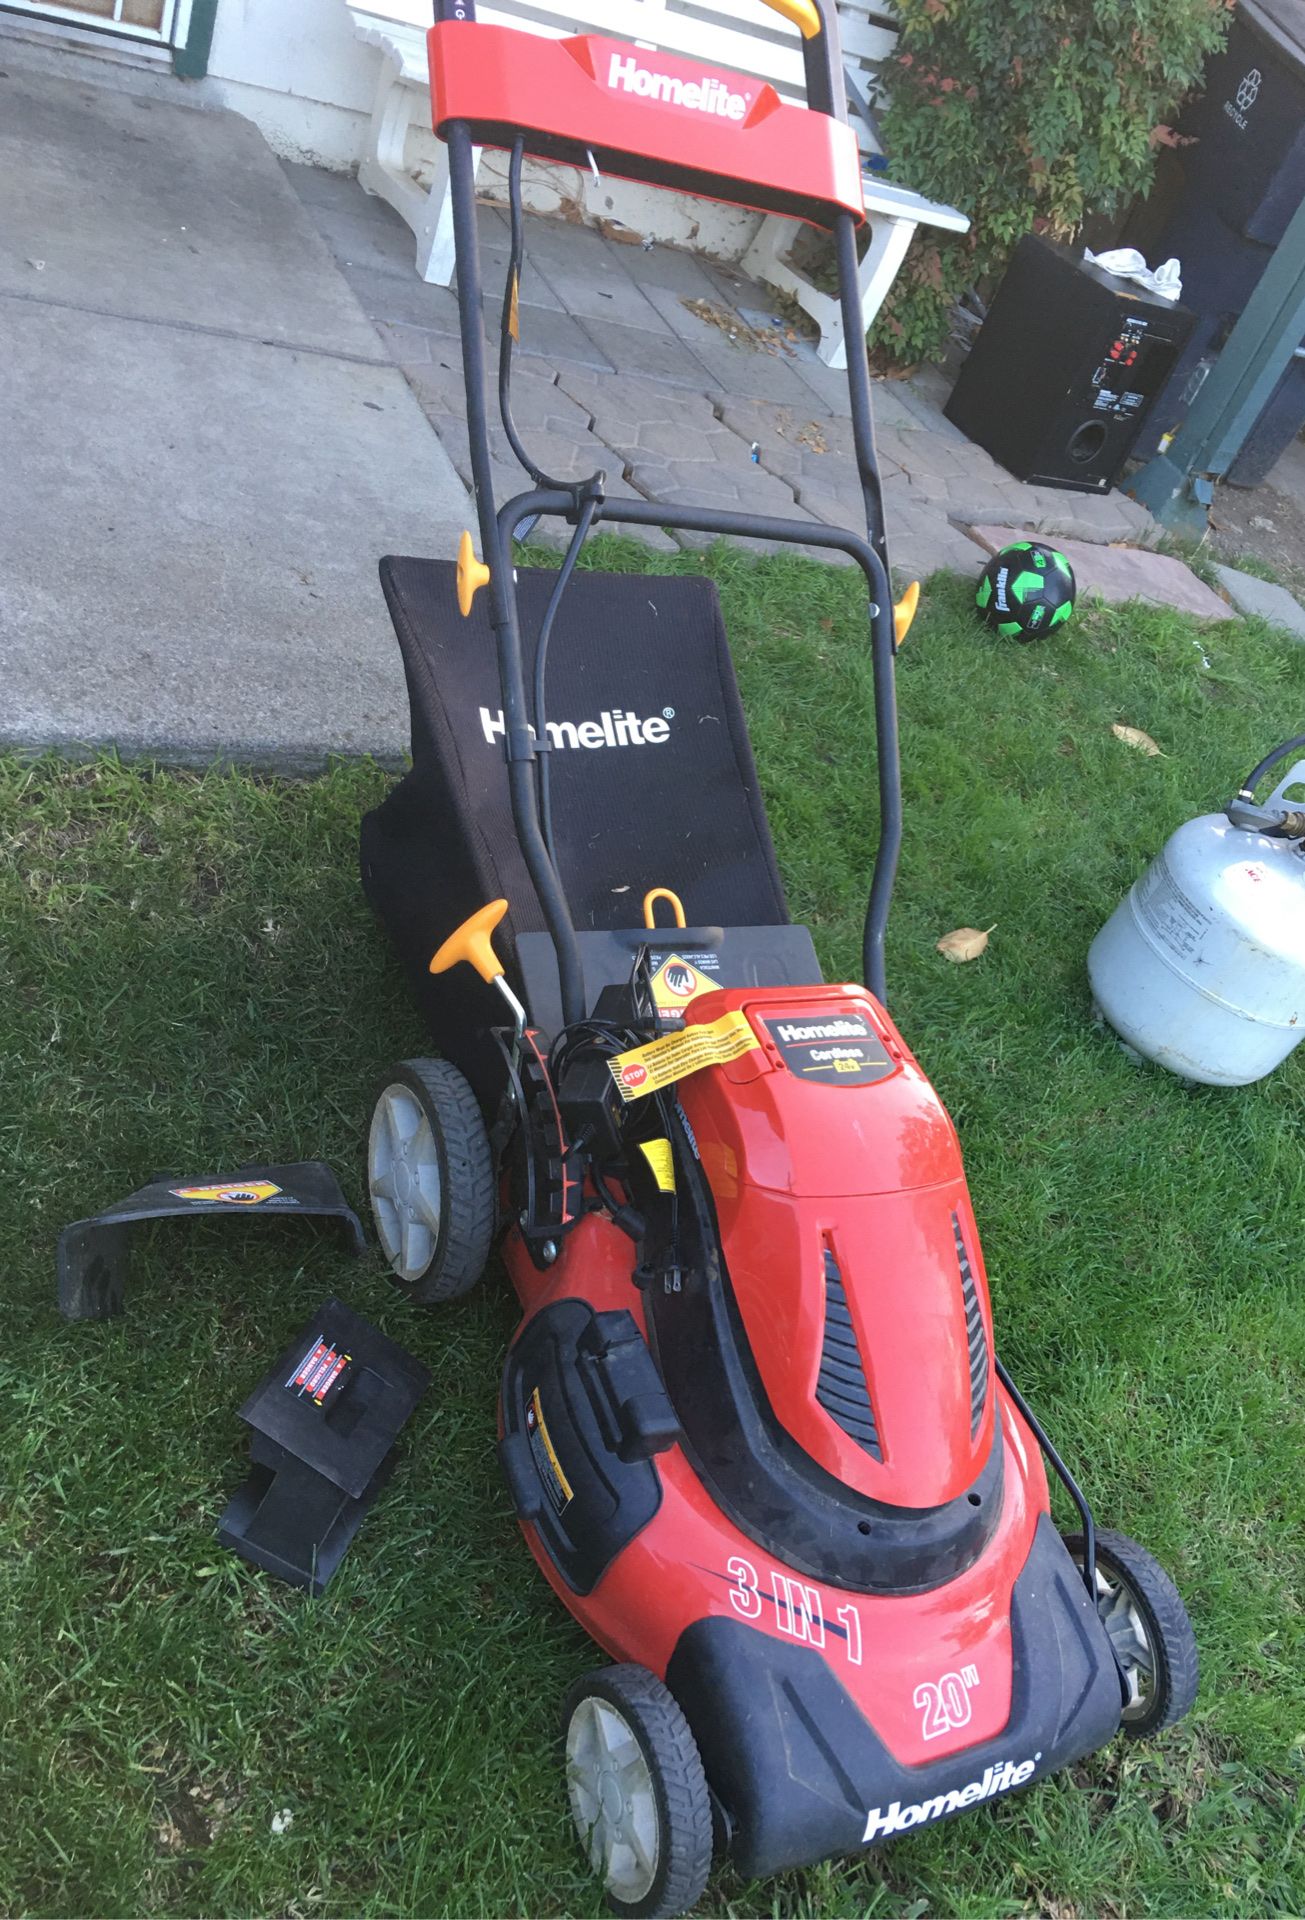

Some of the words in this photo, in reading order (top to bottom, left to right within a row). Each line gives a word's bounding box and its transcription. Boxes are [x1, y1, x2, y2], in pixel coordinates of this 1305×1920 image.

[608, 53, 747, 120] Homelite
[1224, 101, 1248, 130] RECYCLE
[995, 567, 1010, 611] franklin
[479, 706, 671, 749] Hmelite
[777, 1021, 867, 1042] Homelite
[624, 1069, 646, 1083] STOP
[727, 1557, 763, 1619] 3
[770, 1571, 826, 1649] IN
[837, 1604, 863, 1665] 1
[913, 1664, 980, 1741] 20"
[862, 1761, 1037, 1842] Homelite
